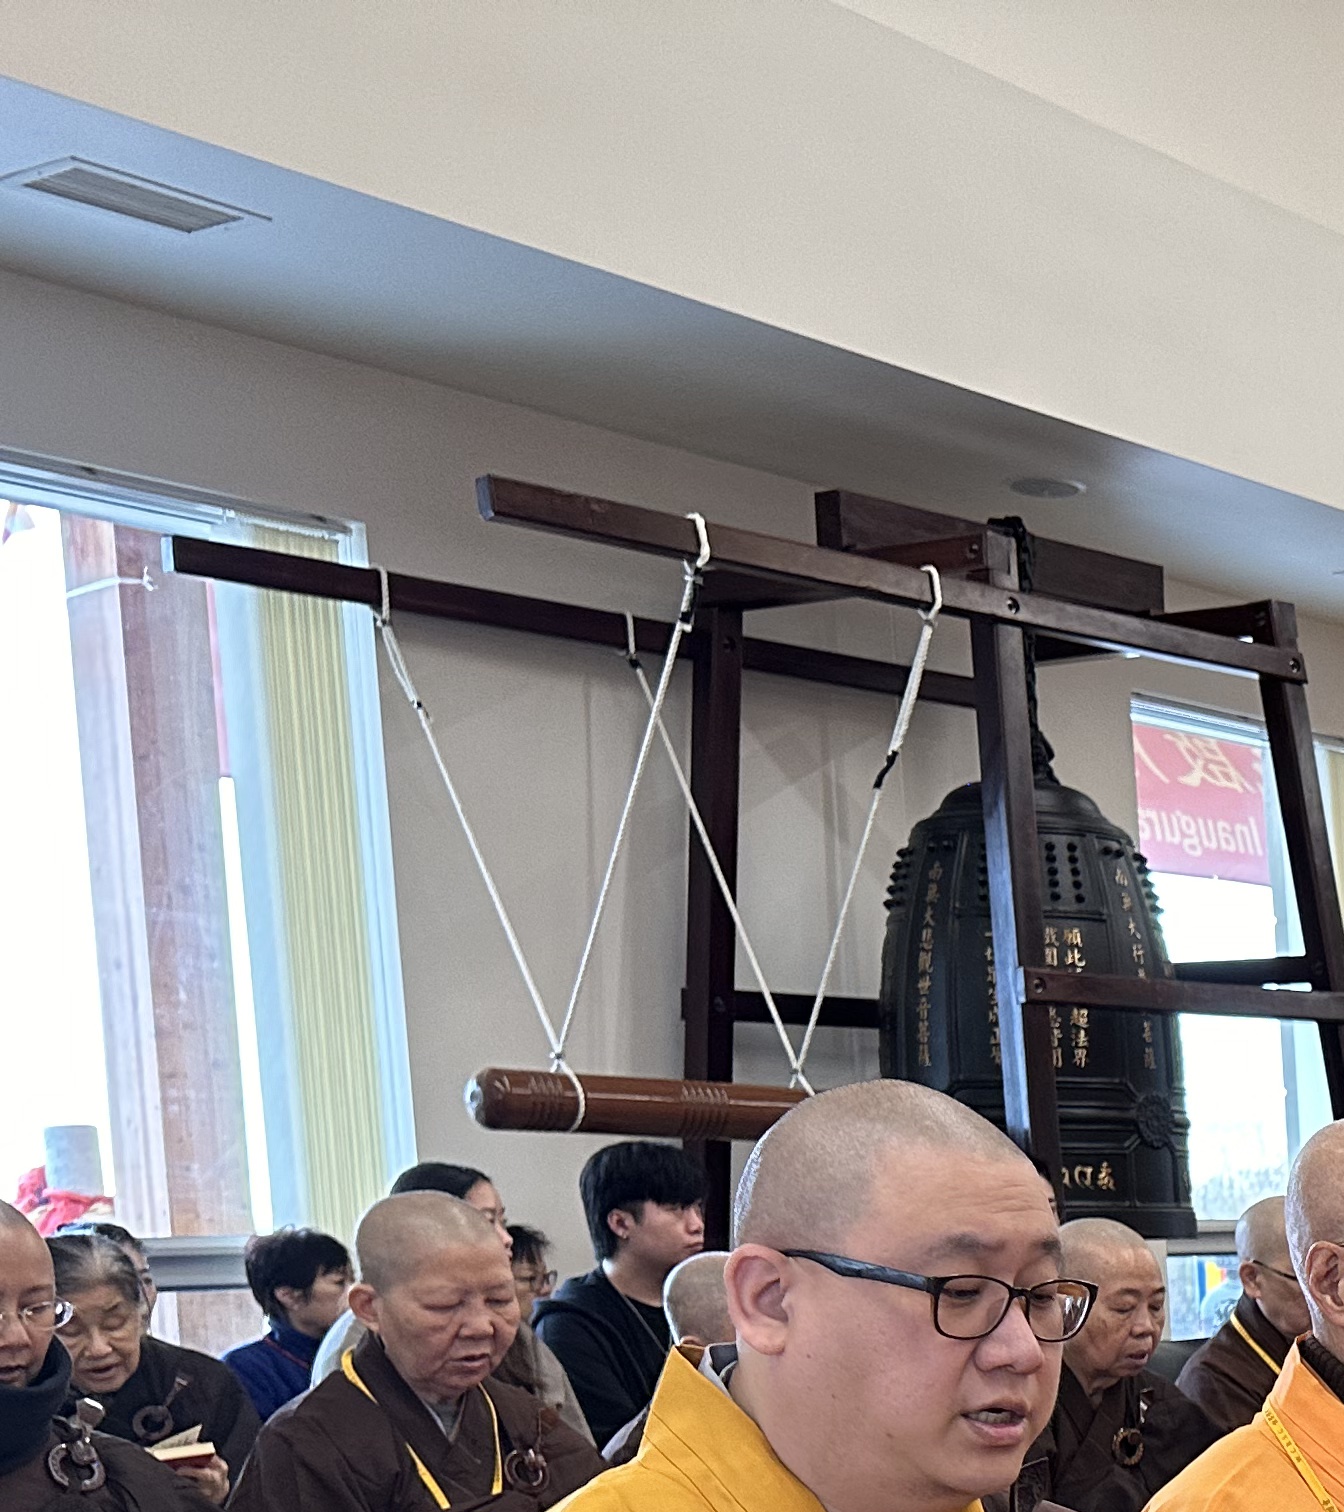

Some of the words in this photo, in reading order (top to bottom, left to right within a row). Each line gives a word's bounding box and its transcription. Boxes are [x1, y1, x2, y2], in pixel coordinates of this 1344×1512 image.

[1063, 927, 1090, 1068] 願此超法界
[1115, 868, 1157, 1070] 南無大行菩薩
